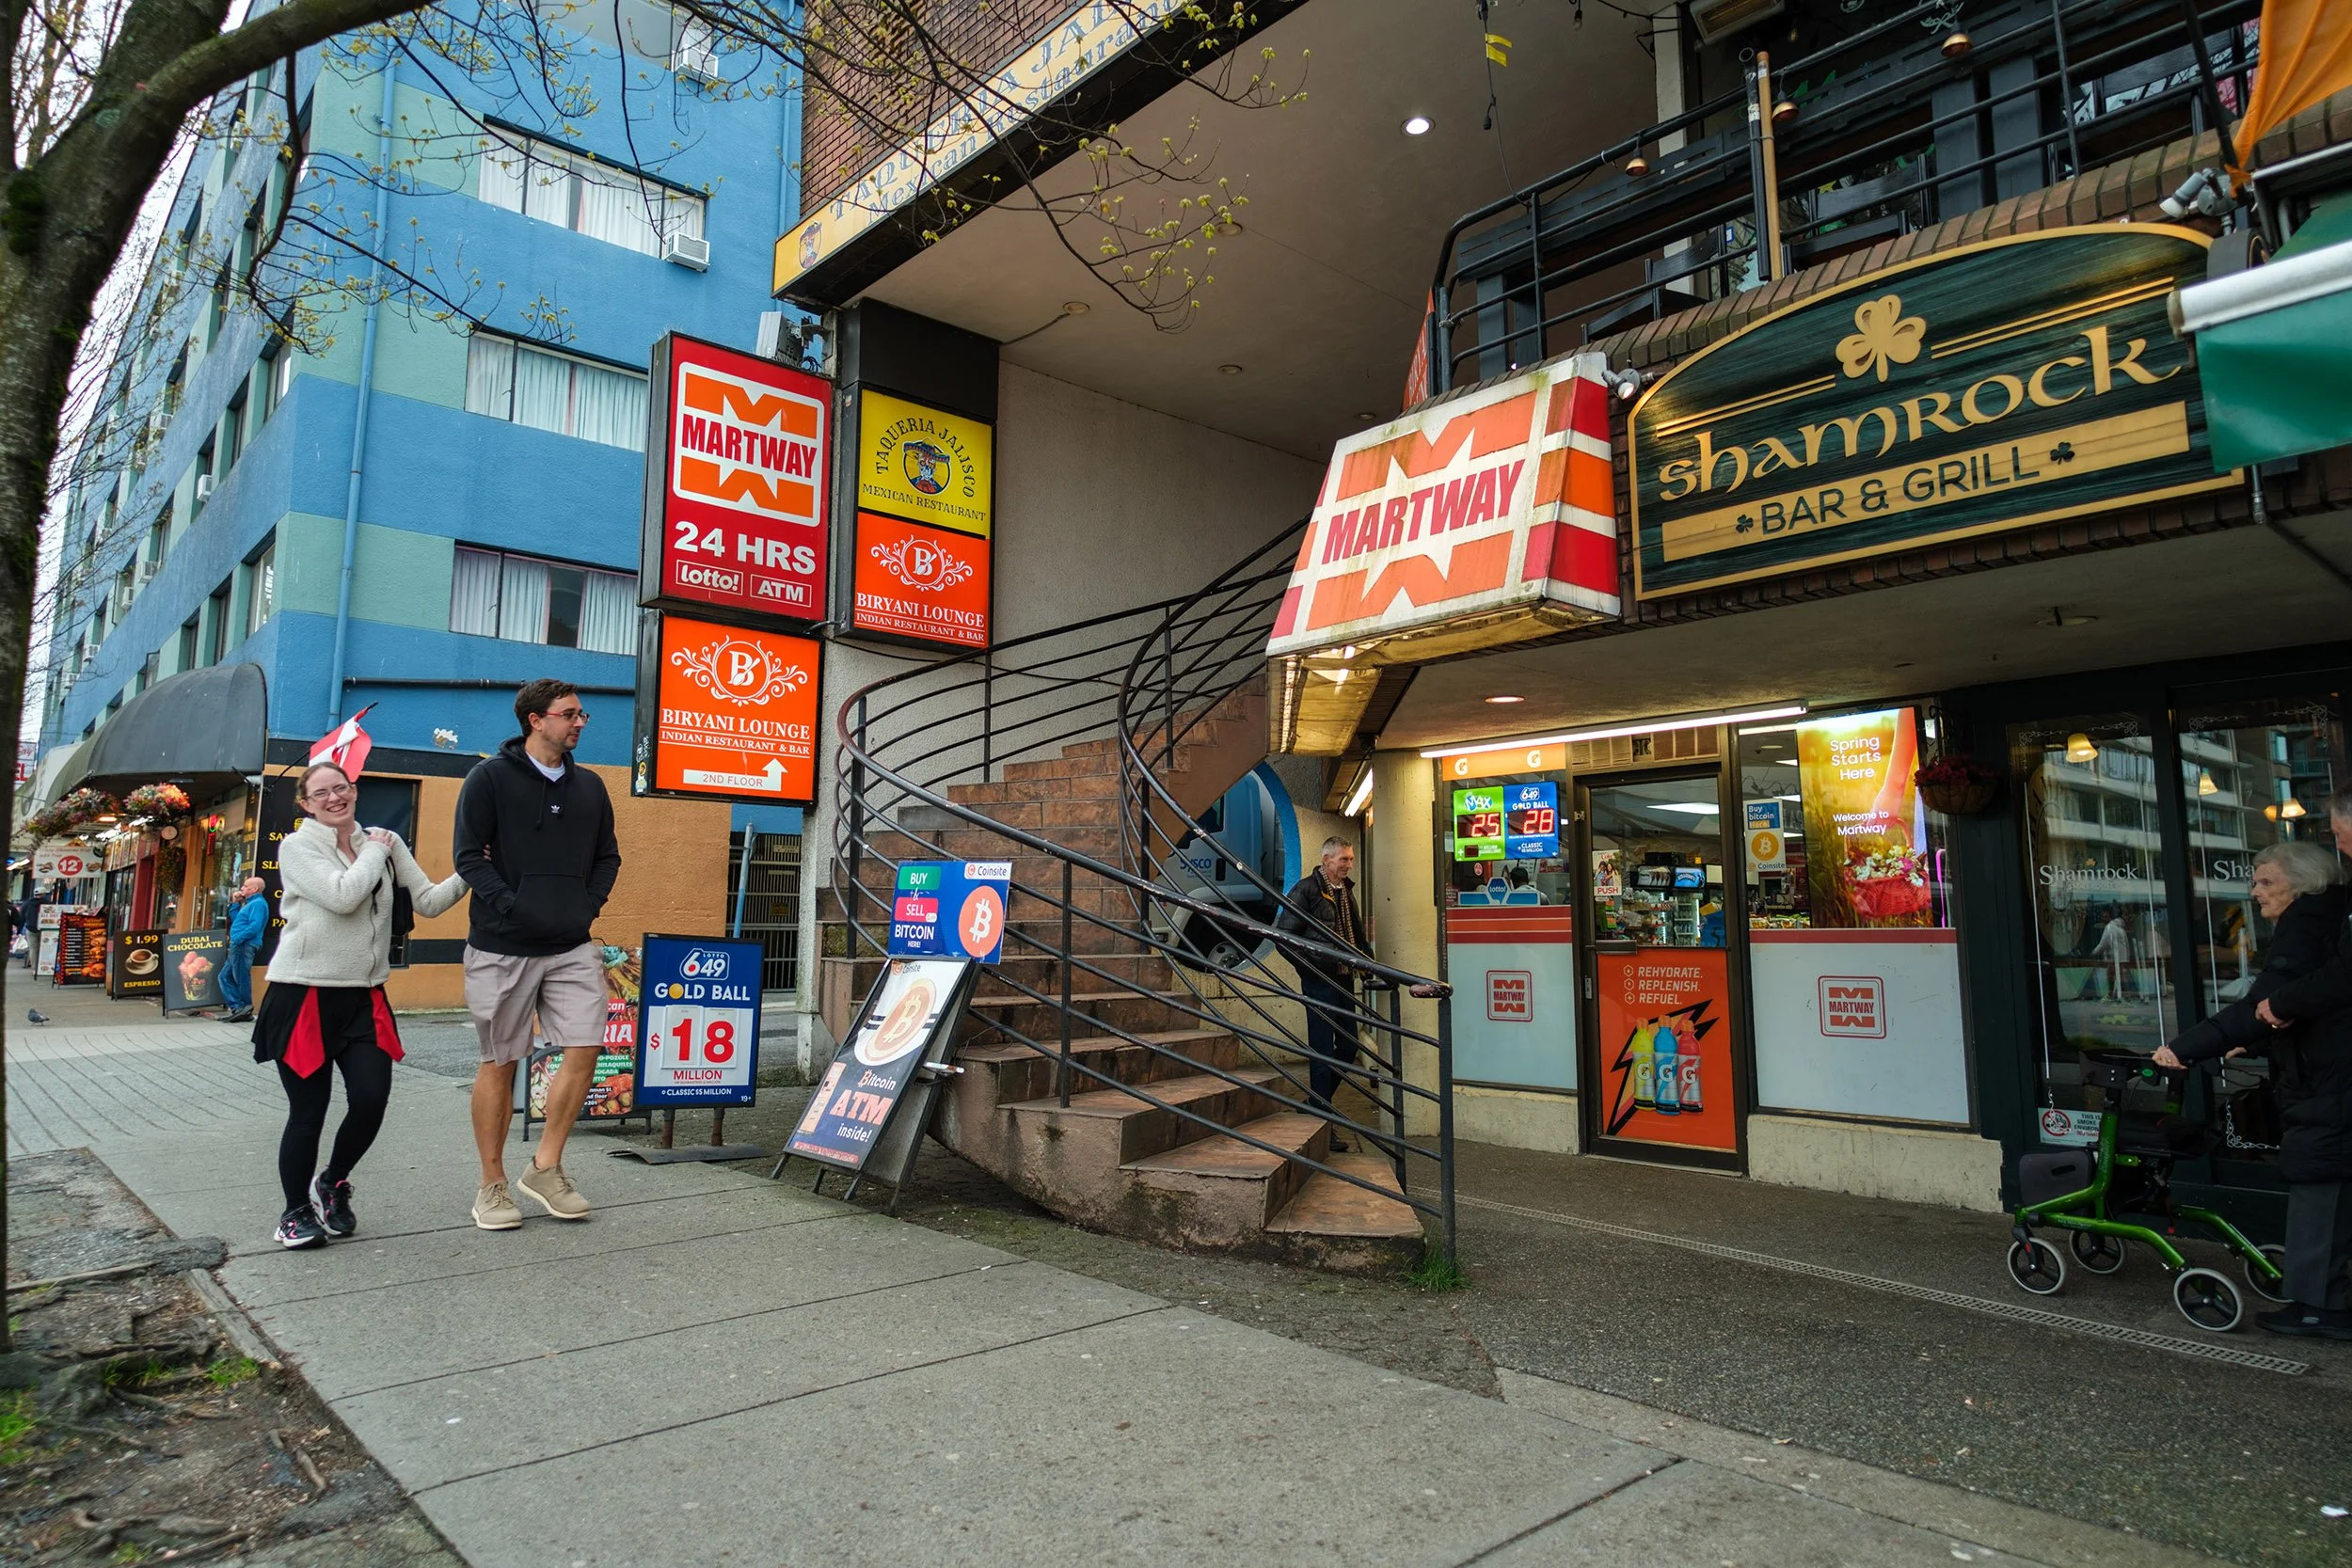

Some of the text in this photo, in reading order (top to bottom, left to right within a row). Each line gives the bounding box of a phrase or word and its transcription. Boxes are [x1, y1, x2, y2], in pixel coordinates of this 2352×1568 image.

[681, 413, 818, 479] MARTWAY
[875, 418, 976, 499] TAQUERIA JALISCO
[1760, 446, 2041, 535] BAR & GRILL
[863, 483, 987, 521] MEXICAN RESTAURANT
[1322, 459, 1526, 564] MARTWAY
[674, 521, 816, 575] 24 HRS
[757, 579, 803, 602] ATM
[857, 593, 985, 627] BIRYANI LOUNGE
[856, 612, 892, 626] INDIAN
[894, 619, 955, 637] RESTAURANT
[966, 632, 985, 641] BAR
[661, 708, 810, 740] BIRYANI LOUNGE
[661, 731, 810, 755] INDIAN RESTAURANT & BAR
[1830, 736, 1880, 753] Spring
[1831, 752, 1882, 767] Starts
[702, 774, 763, 787] 2ND FLOOR
[1840, 768, 1875, 781] Here
[1471, 813, 1500, 837] 25
[1523, 809, 1555, 834] 28
[1833, 810, 1889, 823] Welcome to
[1837, 823, 1887, 836] Martway
[910, 873, 929, 884] BUY
[977, 866, 1008, 876] Coinsite
[2039, 863, 2138, 885] Shamrock
[906, 904, 925, 916] SELL
[125, 935, 159, 945] $ 1.99
[181, 936, 210, 944] DUBAI
[895, 925, 935, 940] BITCOIN
[167, 941, 223, 952] CHOCOLATE
[1638, 966, 1703, 978] REHYDRATE.
[654, 983, 750, 1001] GOLD BALL
[1638, 979, 1701, 992] REPLENISH.
[1493, 990, 1525, 1001] MARTWAY
[1639, 992, 1683, 1005] REFUEL.
[1828, 1001, 1874, 1014] MARTWAY
[650, 1033, 660, 1050] $
[672, 1018, 734, 1064] 18
[673, 1069, 723, 1081] MILLION
[858, 1069, 897, 1091] Bitcoin
[703, 1087, 732, 1096] MILLION
[830, 1089, 894, 1126] ATM
[837, 1122, 872, 1142] inside!
